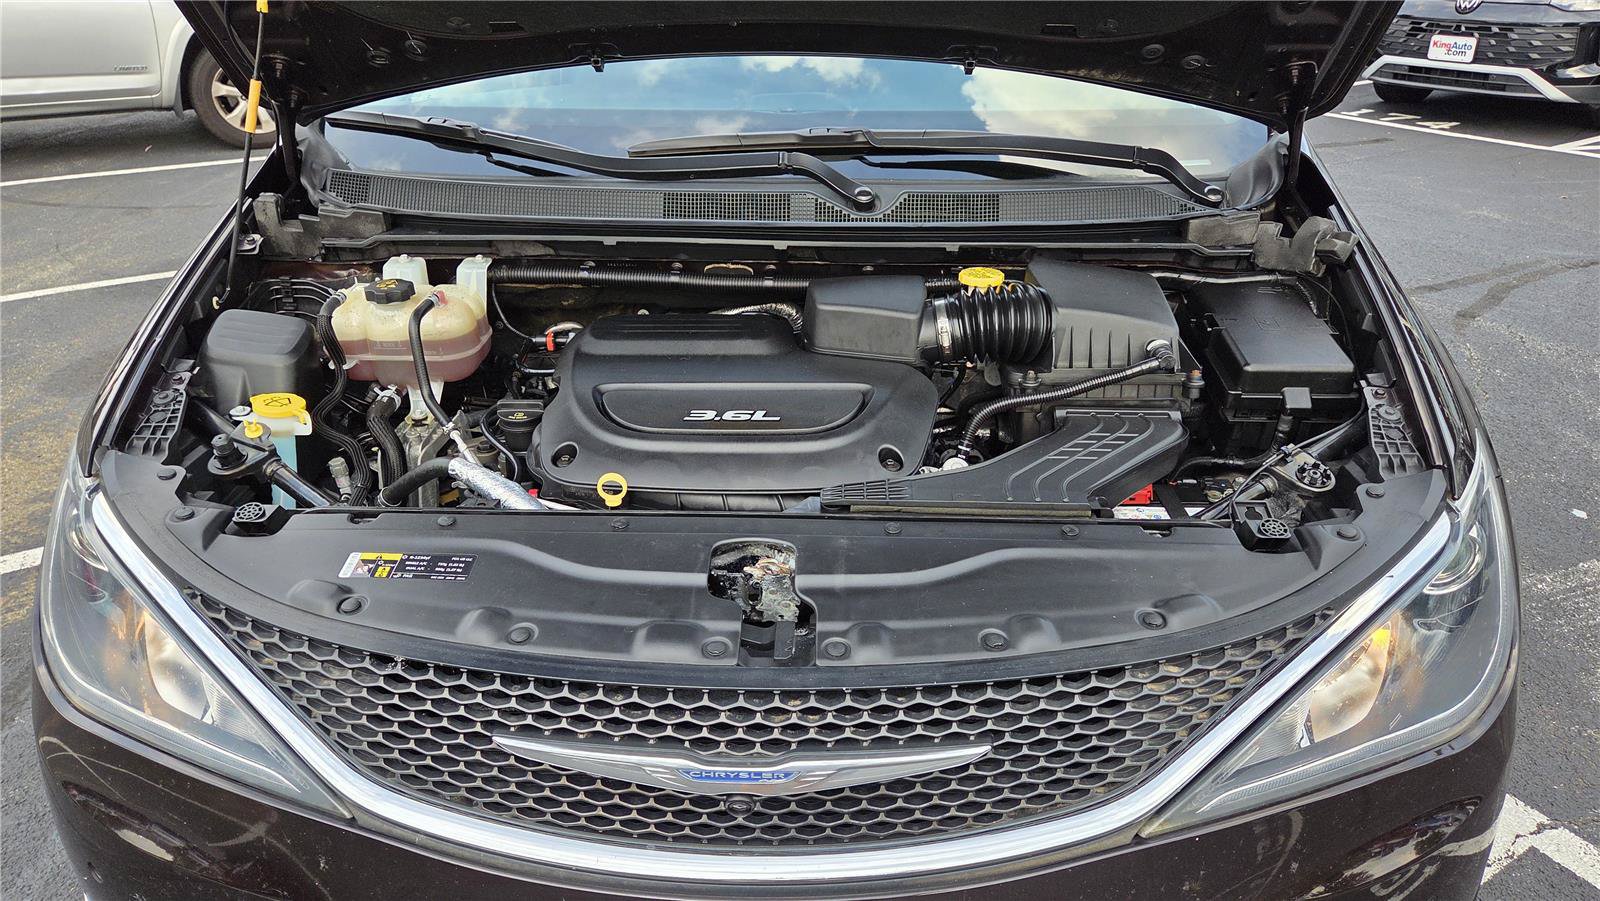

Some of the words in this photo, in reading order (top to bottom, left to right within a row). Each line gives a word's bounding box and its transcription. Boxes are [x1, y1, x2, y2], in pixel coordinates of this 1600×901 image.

[1432, 39, 1473, 51] KingAuto
[1444, 49, 1467, 57] .com
[683, 410, 781, 422] 3.6L
[689, 771, 785, 779] CHRYSLER
